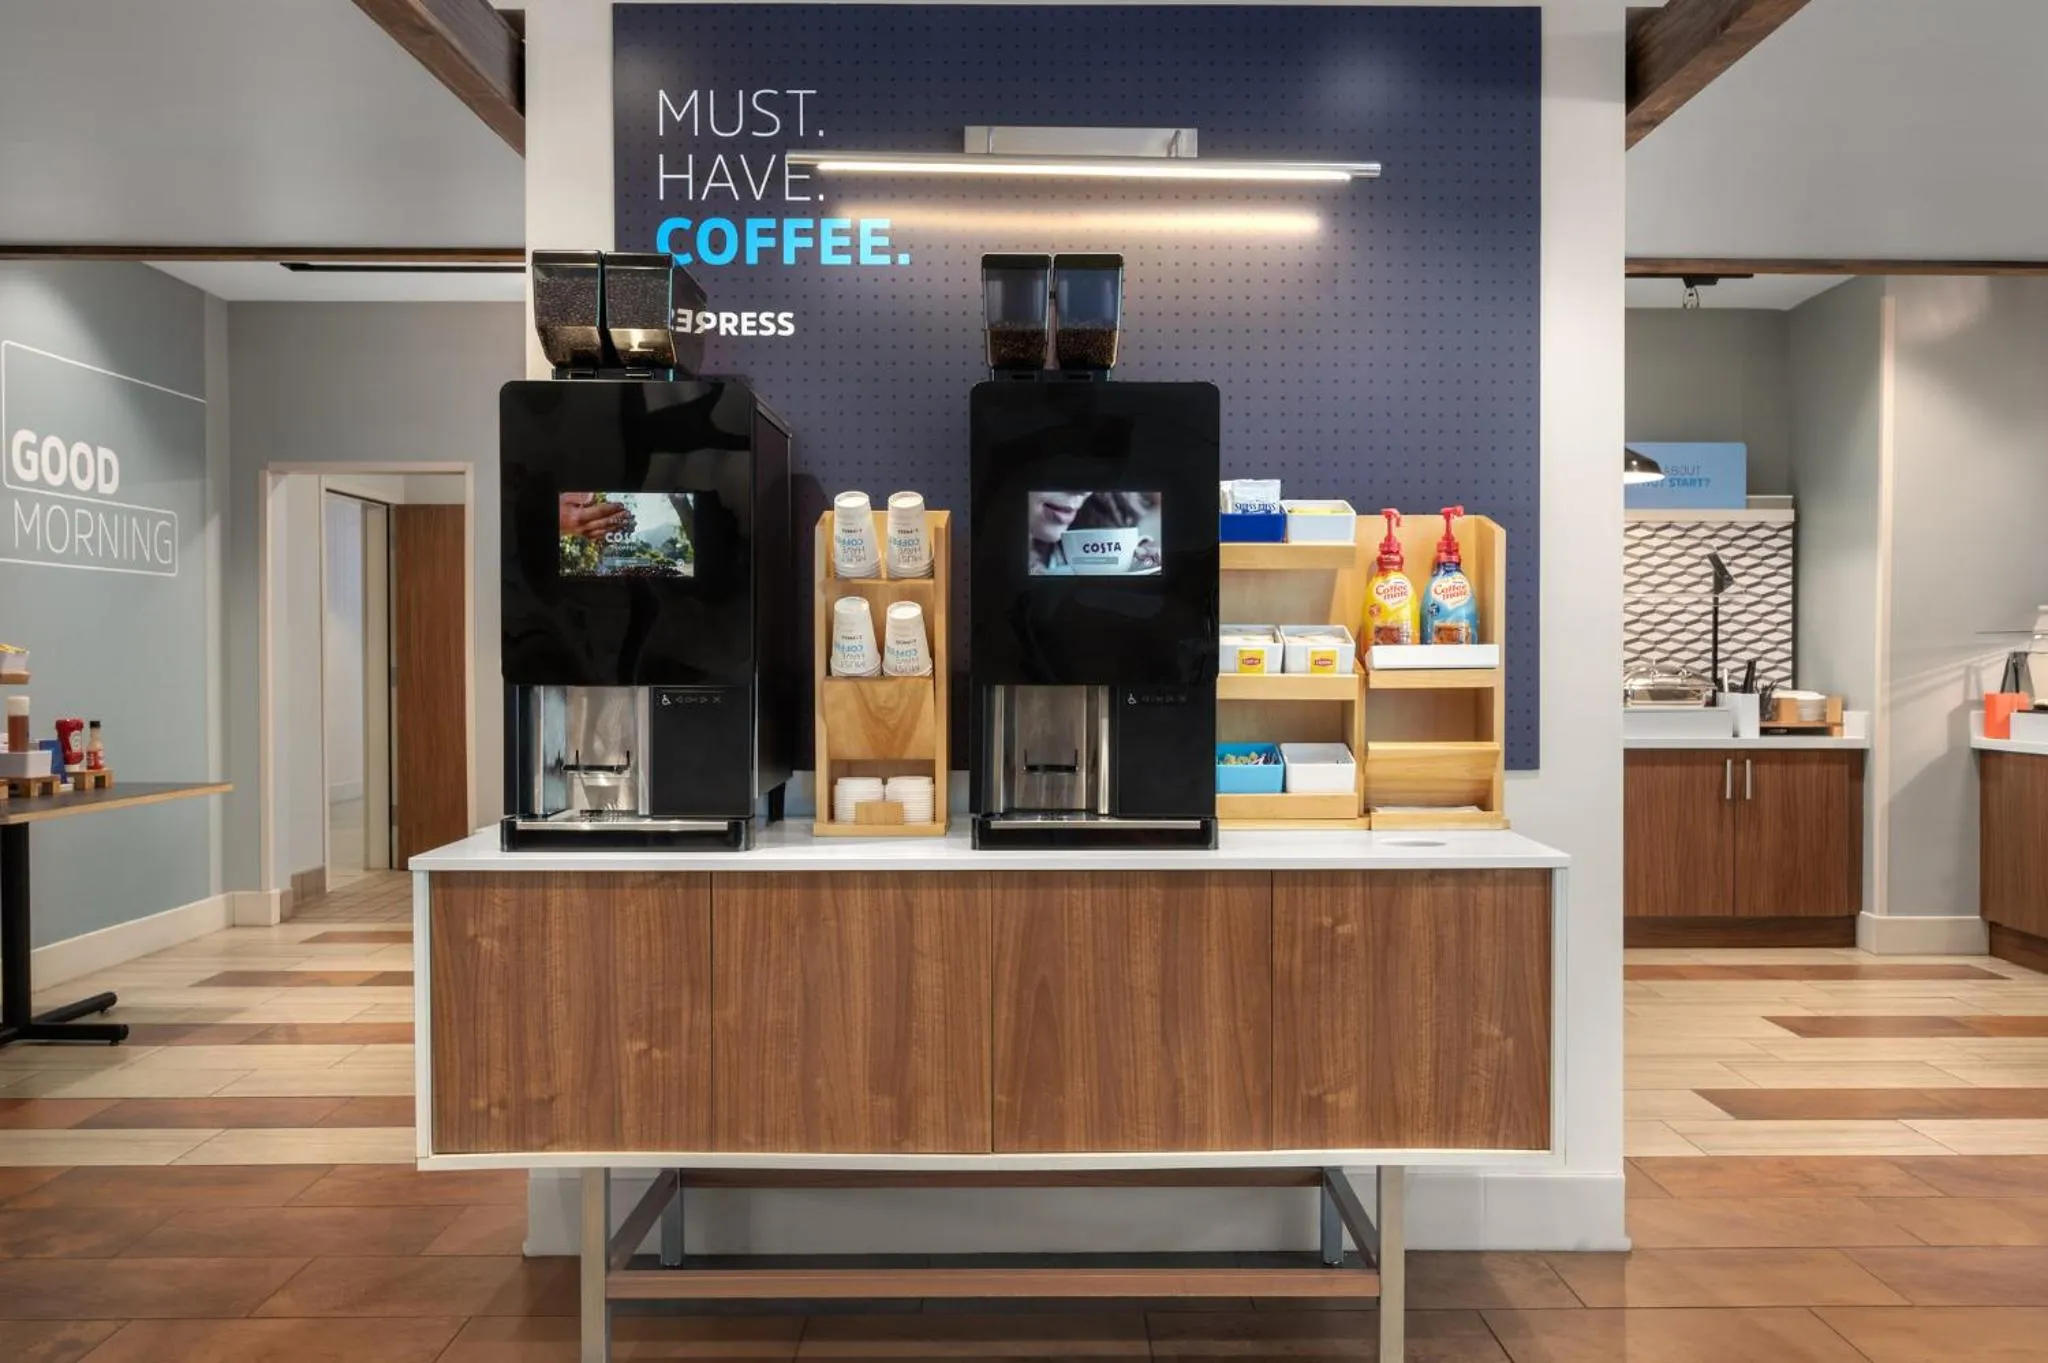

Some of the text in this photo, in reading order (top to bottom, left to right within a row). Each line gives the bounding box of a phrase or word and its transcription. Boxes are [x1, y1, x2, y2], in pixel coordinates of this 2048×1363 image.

[658, 89, 825, 137] MUST.
[658, 153, 825, 201] HAVE.
[656, 216, 911, 266] COFFEE.
[11, 429, 120, 495] GOOD
[14, 498, 173, 565] MORNING
[1082, 541, 1122, 554] COSTA
